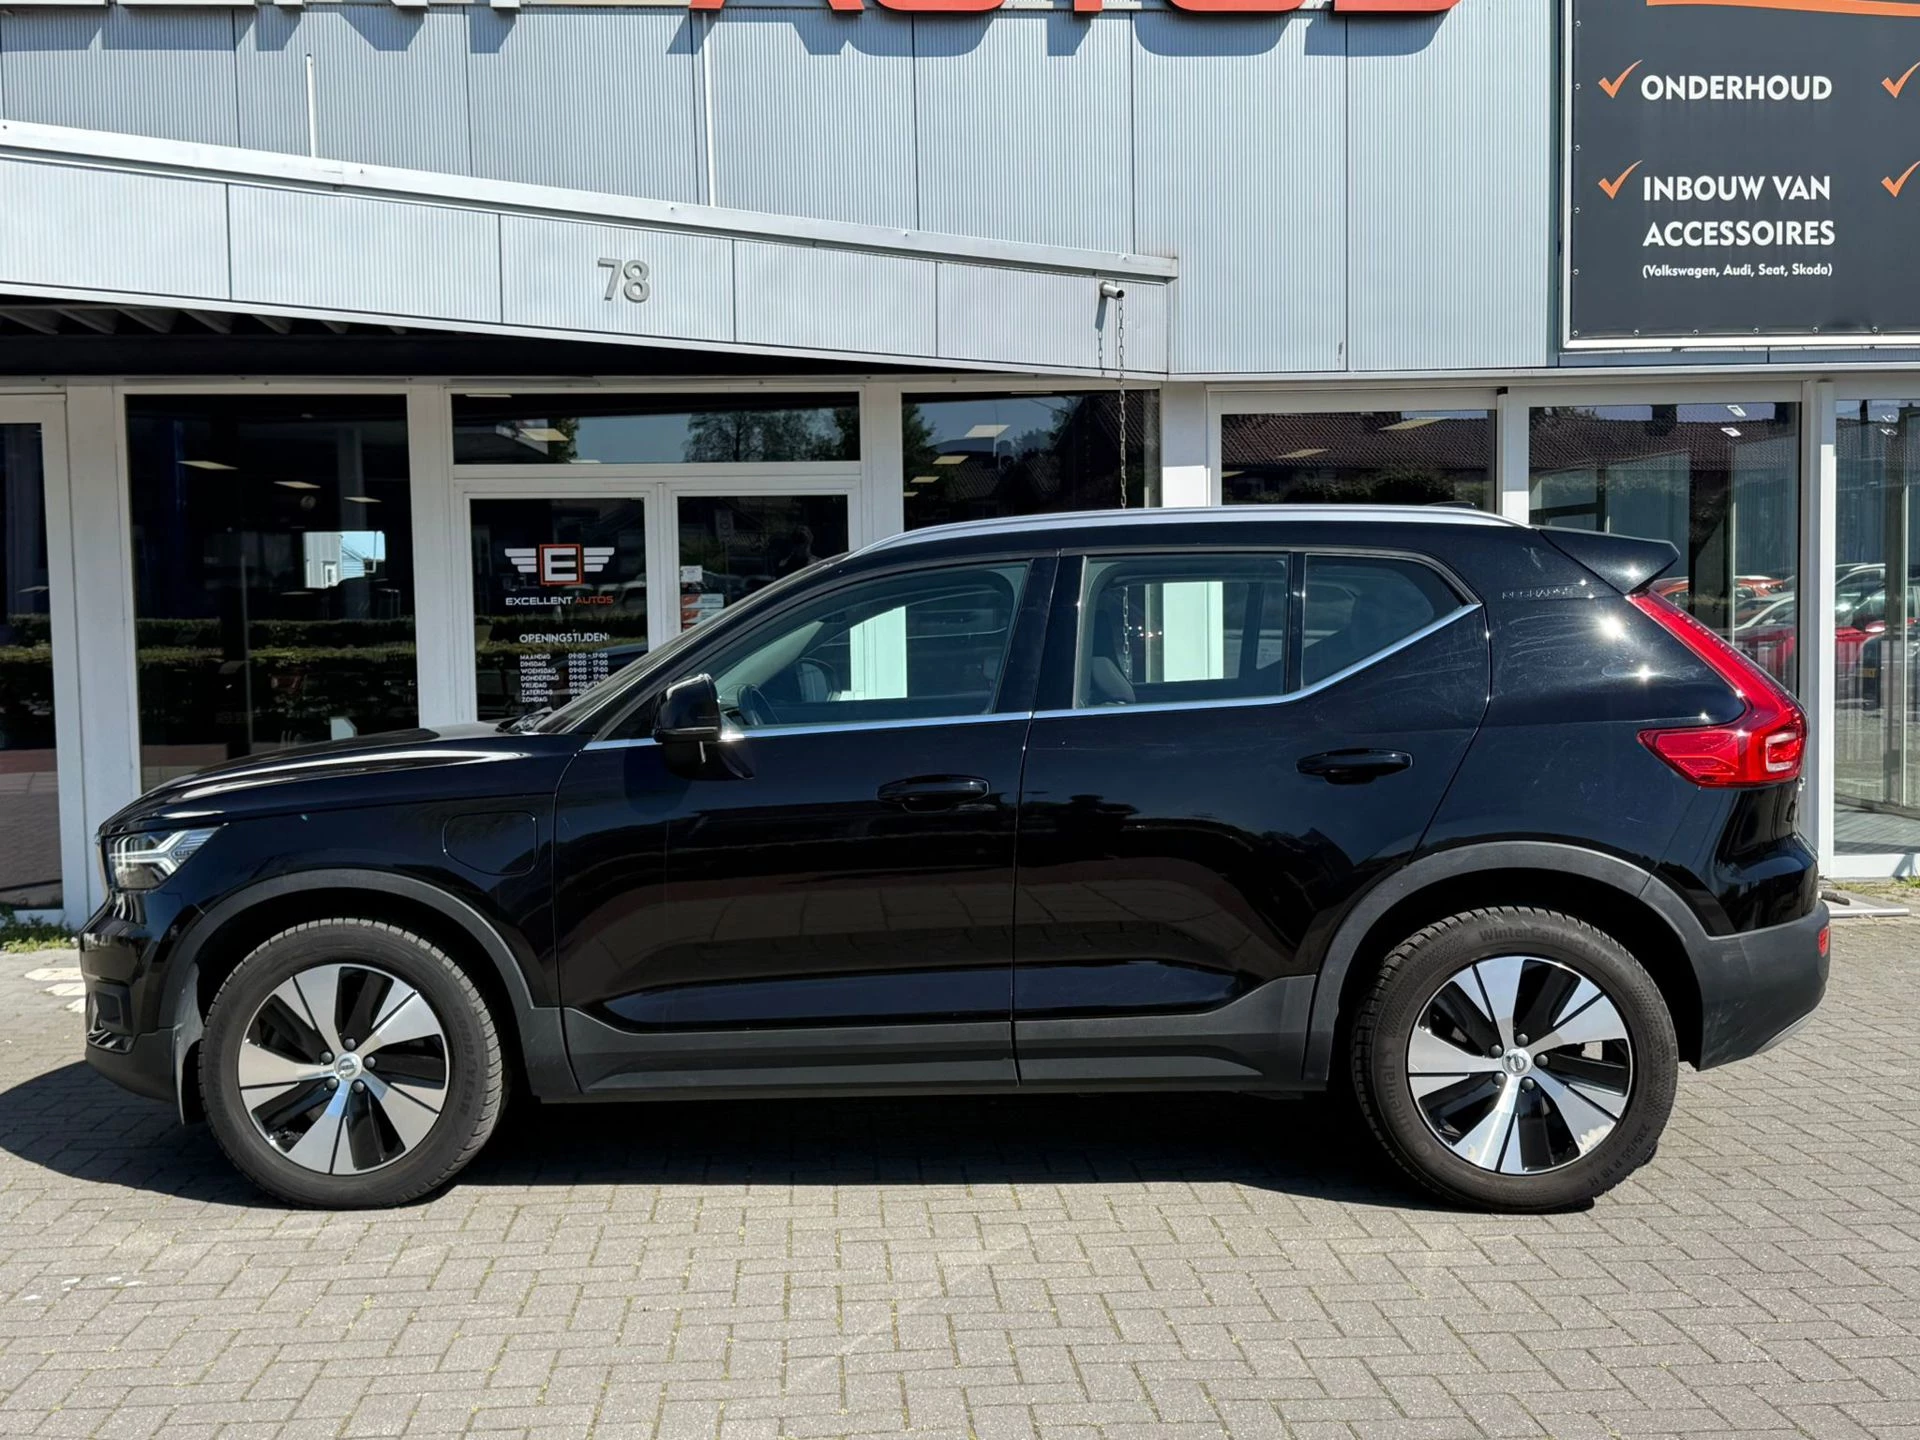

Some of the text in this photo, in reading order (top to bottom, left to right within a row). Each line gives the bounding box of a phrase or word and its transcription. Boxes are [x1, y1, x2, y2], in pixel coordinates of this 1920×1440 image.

[1641, 75, 1833, 101] ONDERHOUD
[1643, 175, 1831, 202] INBOUW VAN
[1642, 220, 1836, 248] ACCESSOIRES
[598, 257, 650, 304] 78
[1642, 263, 1833, 279] (Volkswagen, Audi, Seat, Skoda)
[505, 595, 614, 606] EXCELLENT AUTOS
